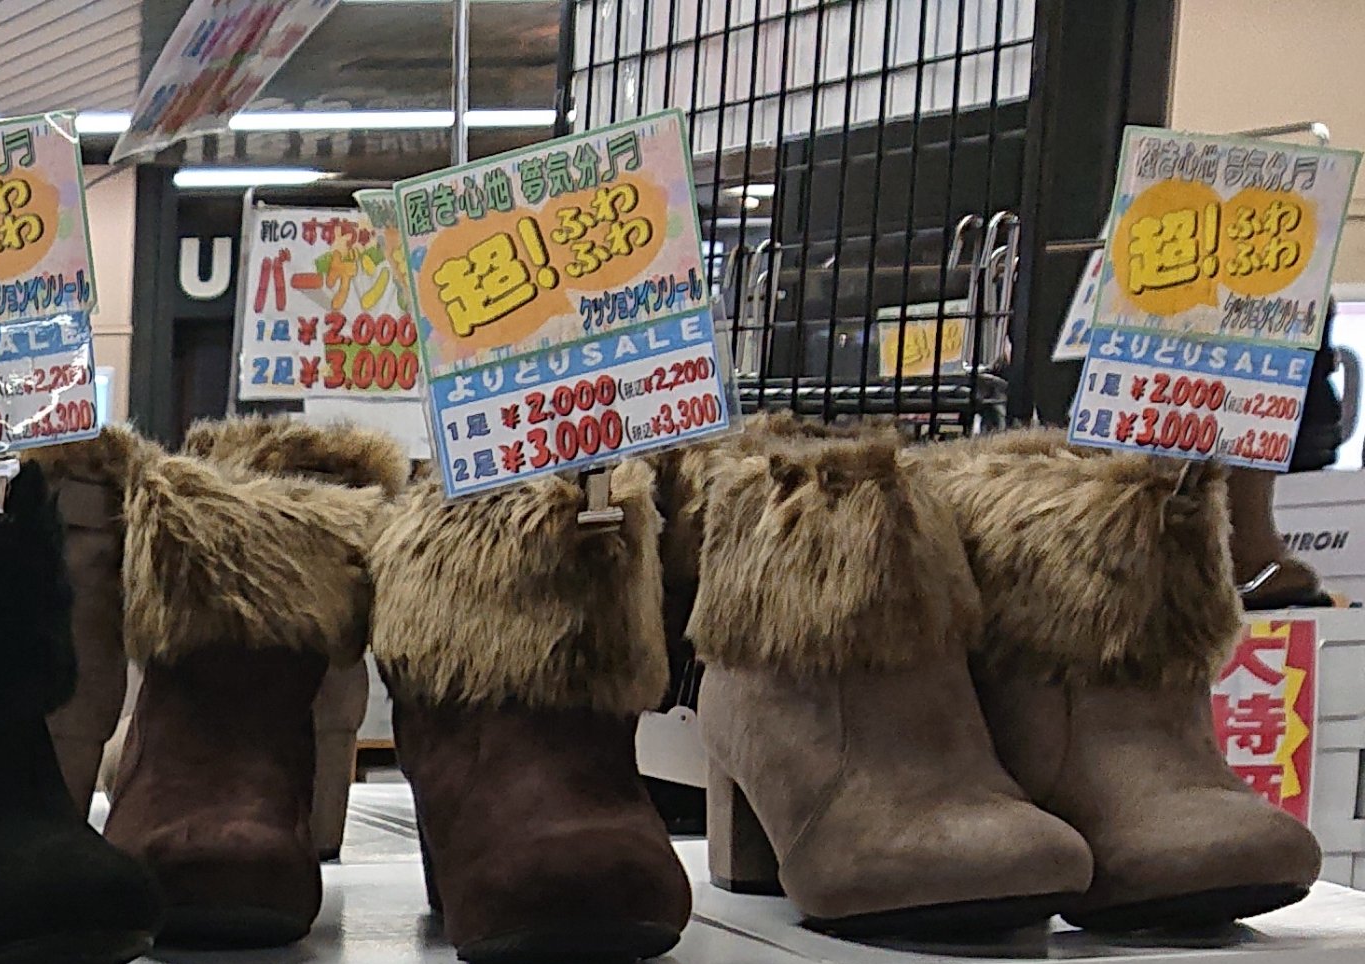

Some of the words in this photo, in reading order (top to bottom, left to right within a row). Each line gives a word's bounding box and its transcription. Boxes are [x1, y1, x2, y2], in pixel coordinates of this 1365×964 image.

[404, 167, 513, 236] 履き心地
[520, 144, 601, 203] 夢気分
[551, 184, 638, 244] ふわ
[1227, 201, 1301, 240] ふわ
[254, 247, 390, 314] バーゲン
[433, 216, 559, 337] 超!
[565, 217, 652, 277] ふわ
[1128, 203, 1221, 295] 超!
[1226, 238, 1300, 275] ふわ
[448, 316, 703, 401] よりどりSALE
[1100, 331, 1306, 380] よりどりSALE
[1214, 625, 1287, 803] 大特
